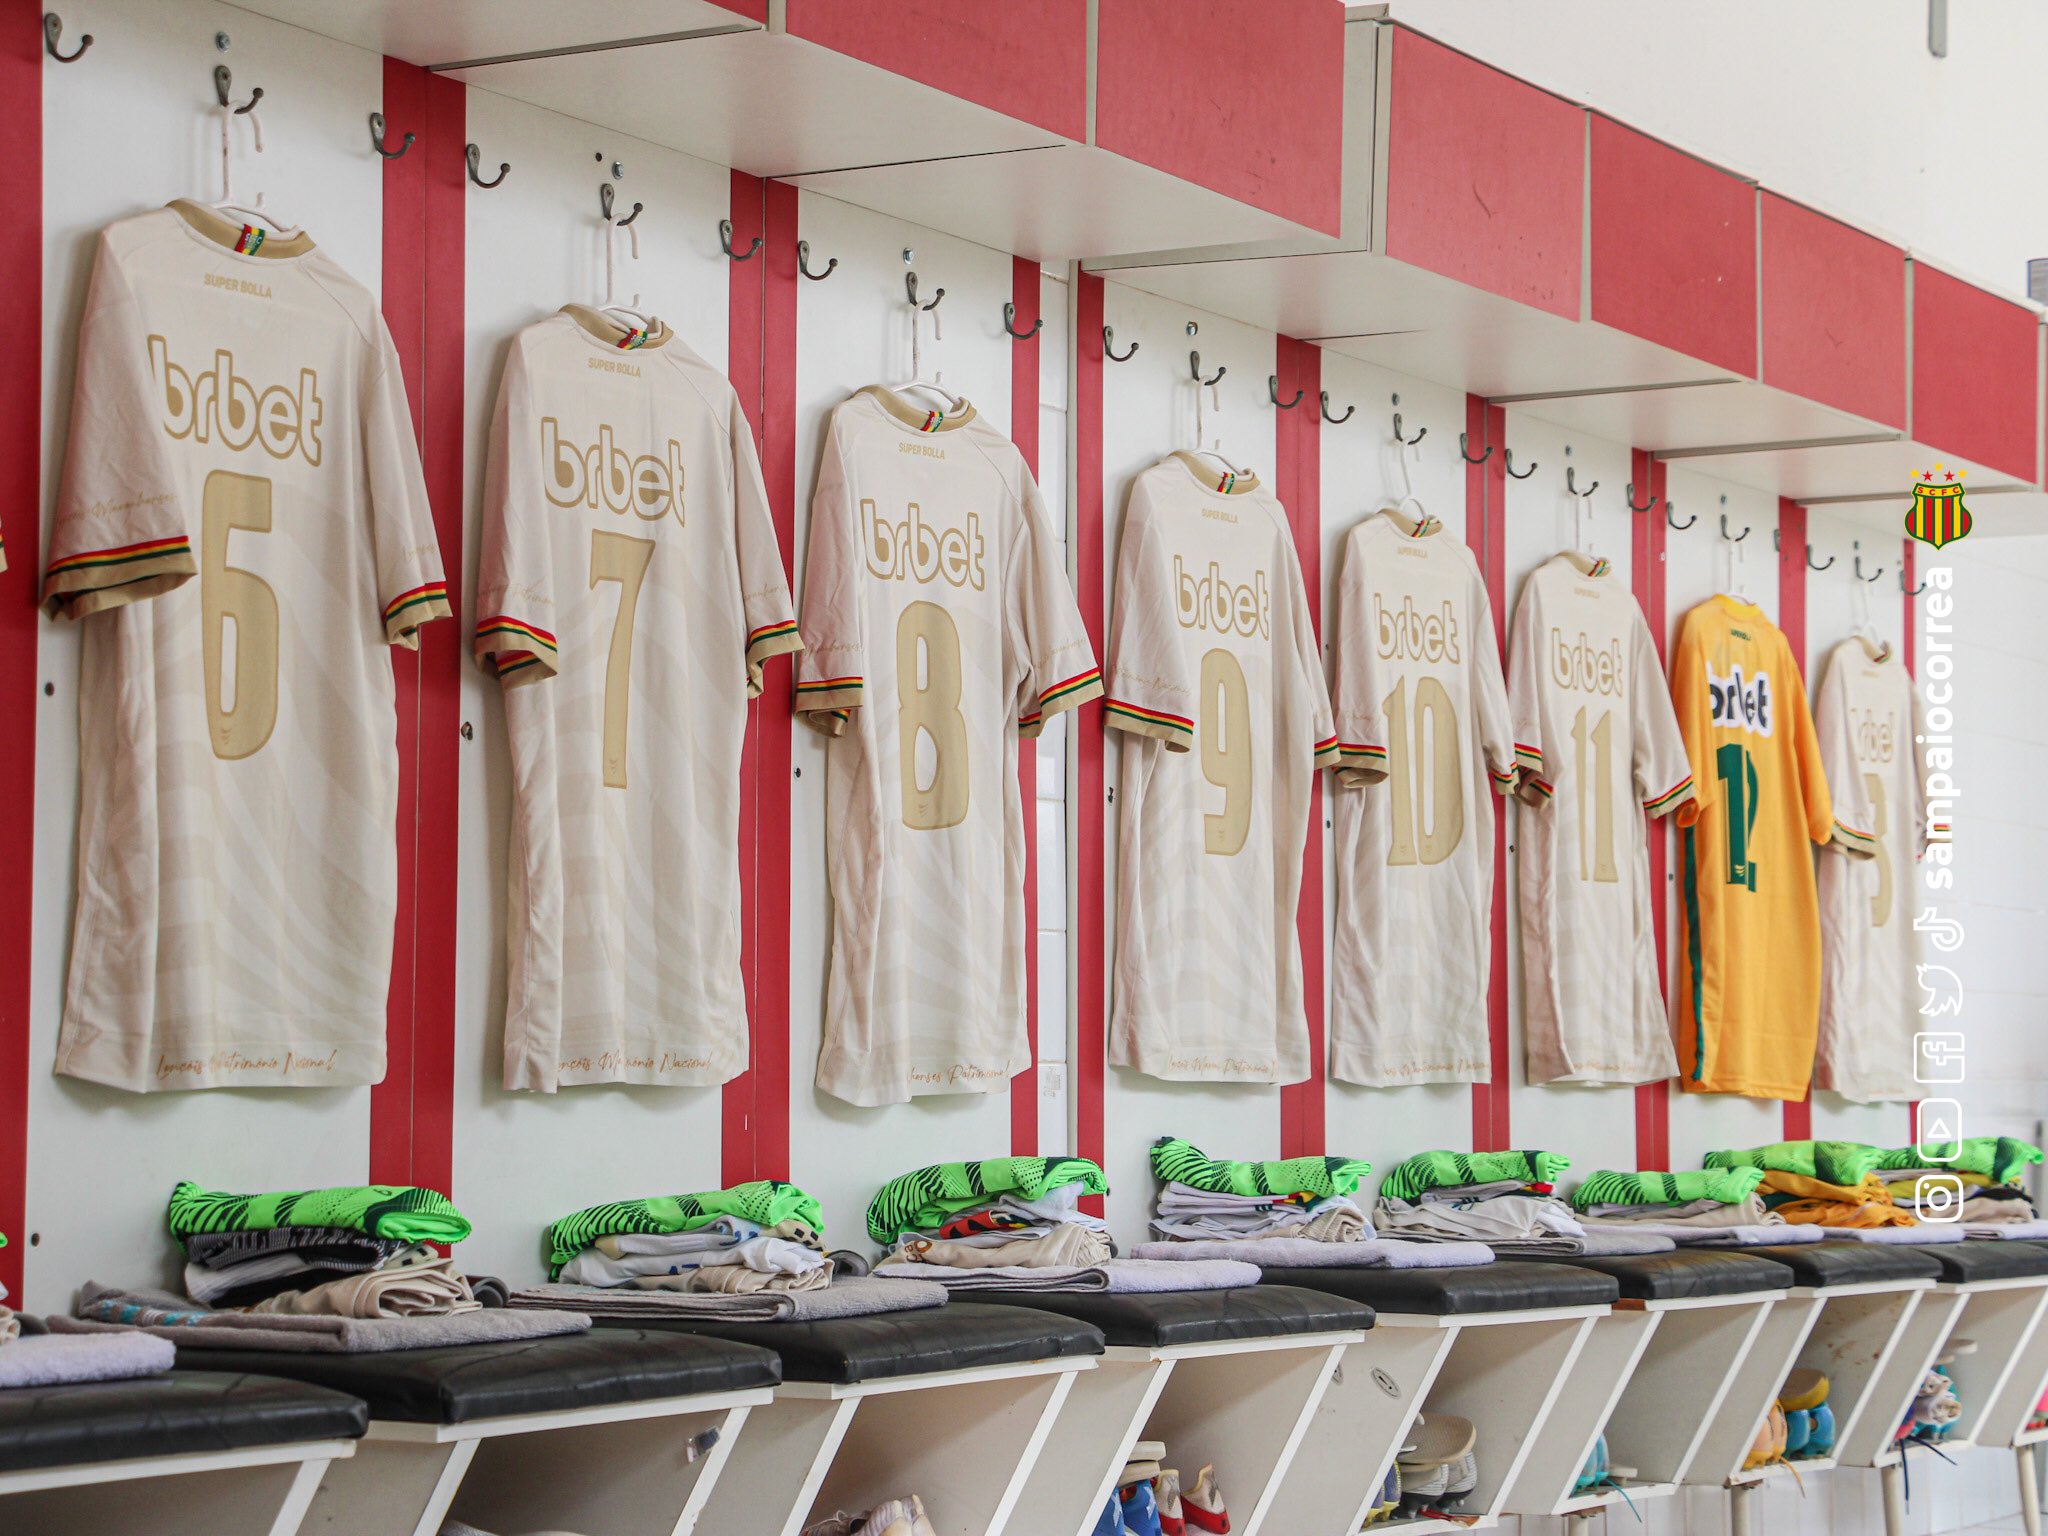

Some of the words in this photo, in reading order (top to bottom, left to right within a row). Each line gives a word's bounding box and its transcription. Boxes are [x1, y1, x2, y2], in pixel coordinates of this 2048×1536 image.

[204, 272, 239, 291] SUPER
[240, 280, 272, 298] BOLLA
[147, 334, 322, 468] brbet
[588, 357, 615, 372] SUPER
[616, 362, 641, 378] BOLLA
[541, 416, 685, 528] brbet
[899, 442, 921, 455] SUPER
[922, 446, 945, 460] BOLLA
[860, 499, 985, 592] brbet
[1173, 554, 1269, 641] brbet
[202, 469, 279, 760] 6
[589, 529, 656, 789] 7
[1374, 593, 1460, 664] brbet
[1552, 627, 1623, 698] brbet
[896, 600, 970, 830] 8
[1199, 647, 1252, 856] 9
[1382, 675, 1464, 866] 10
[1571, 706, 1618, 883] 11
